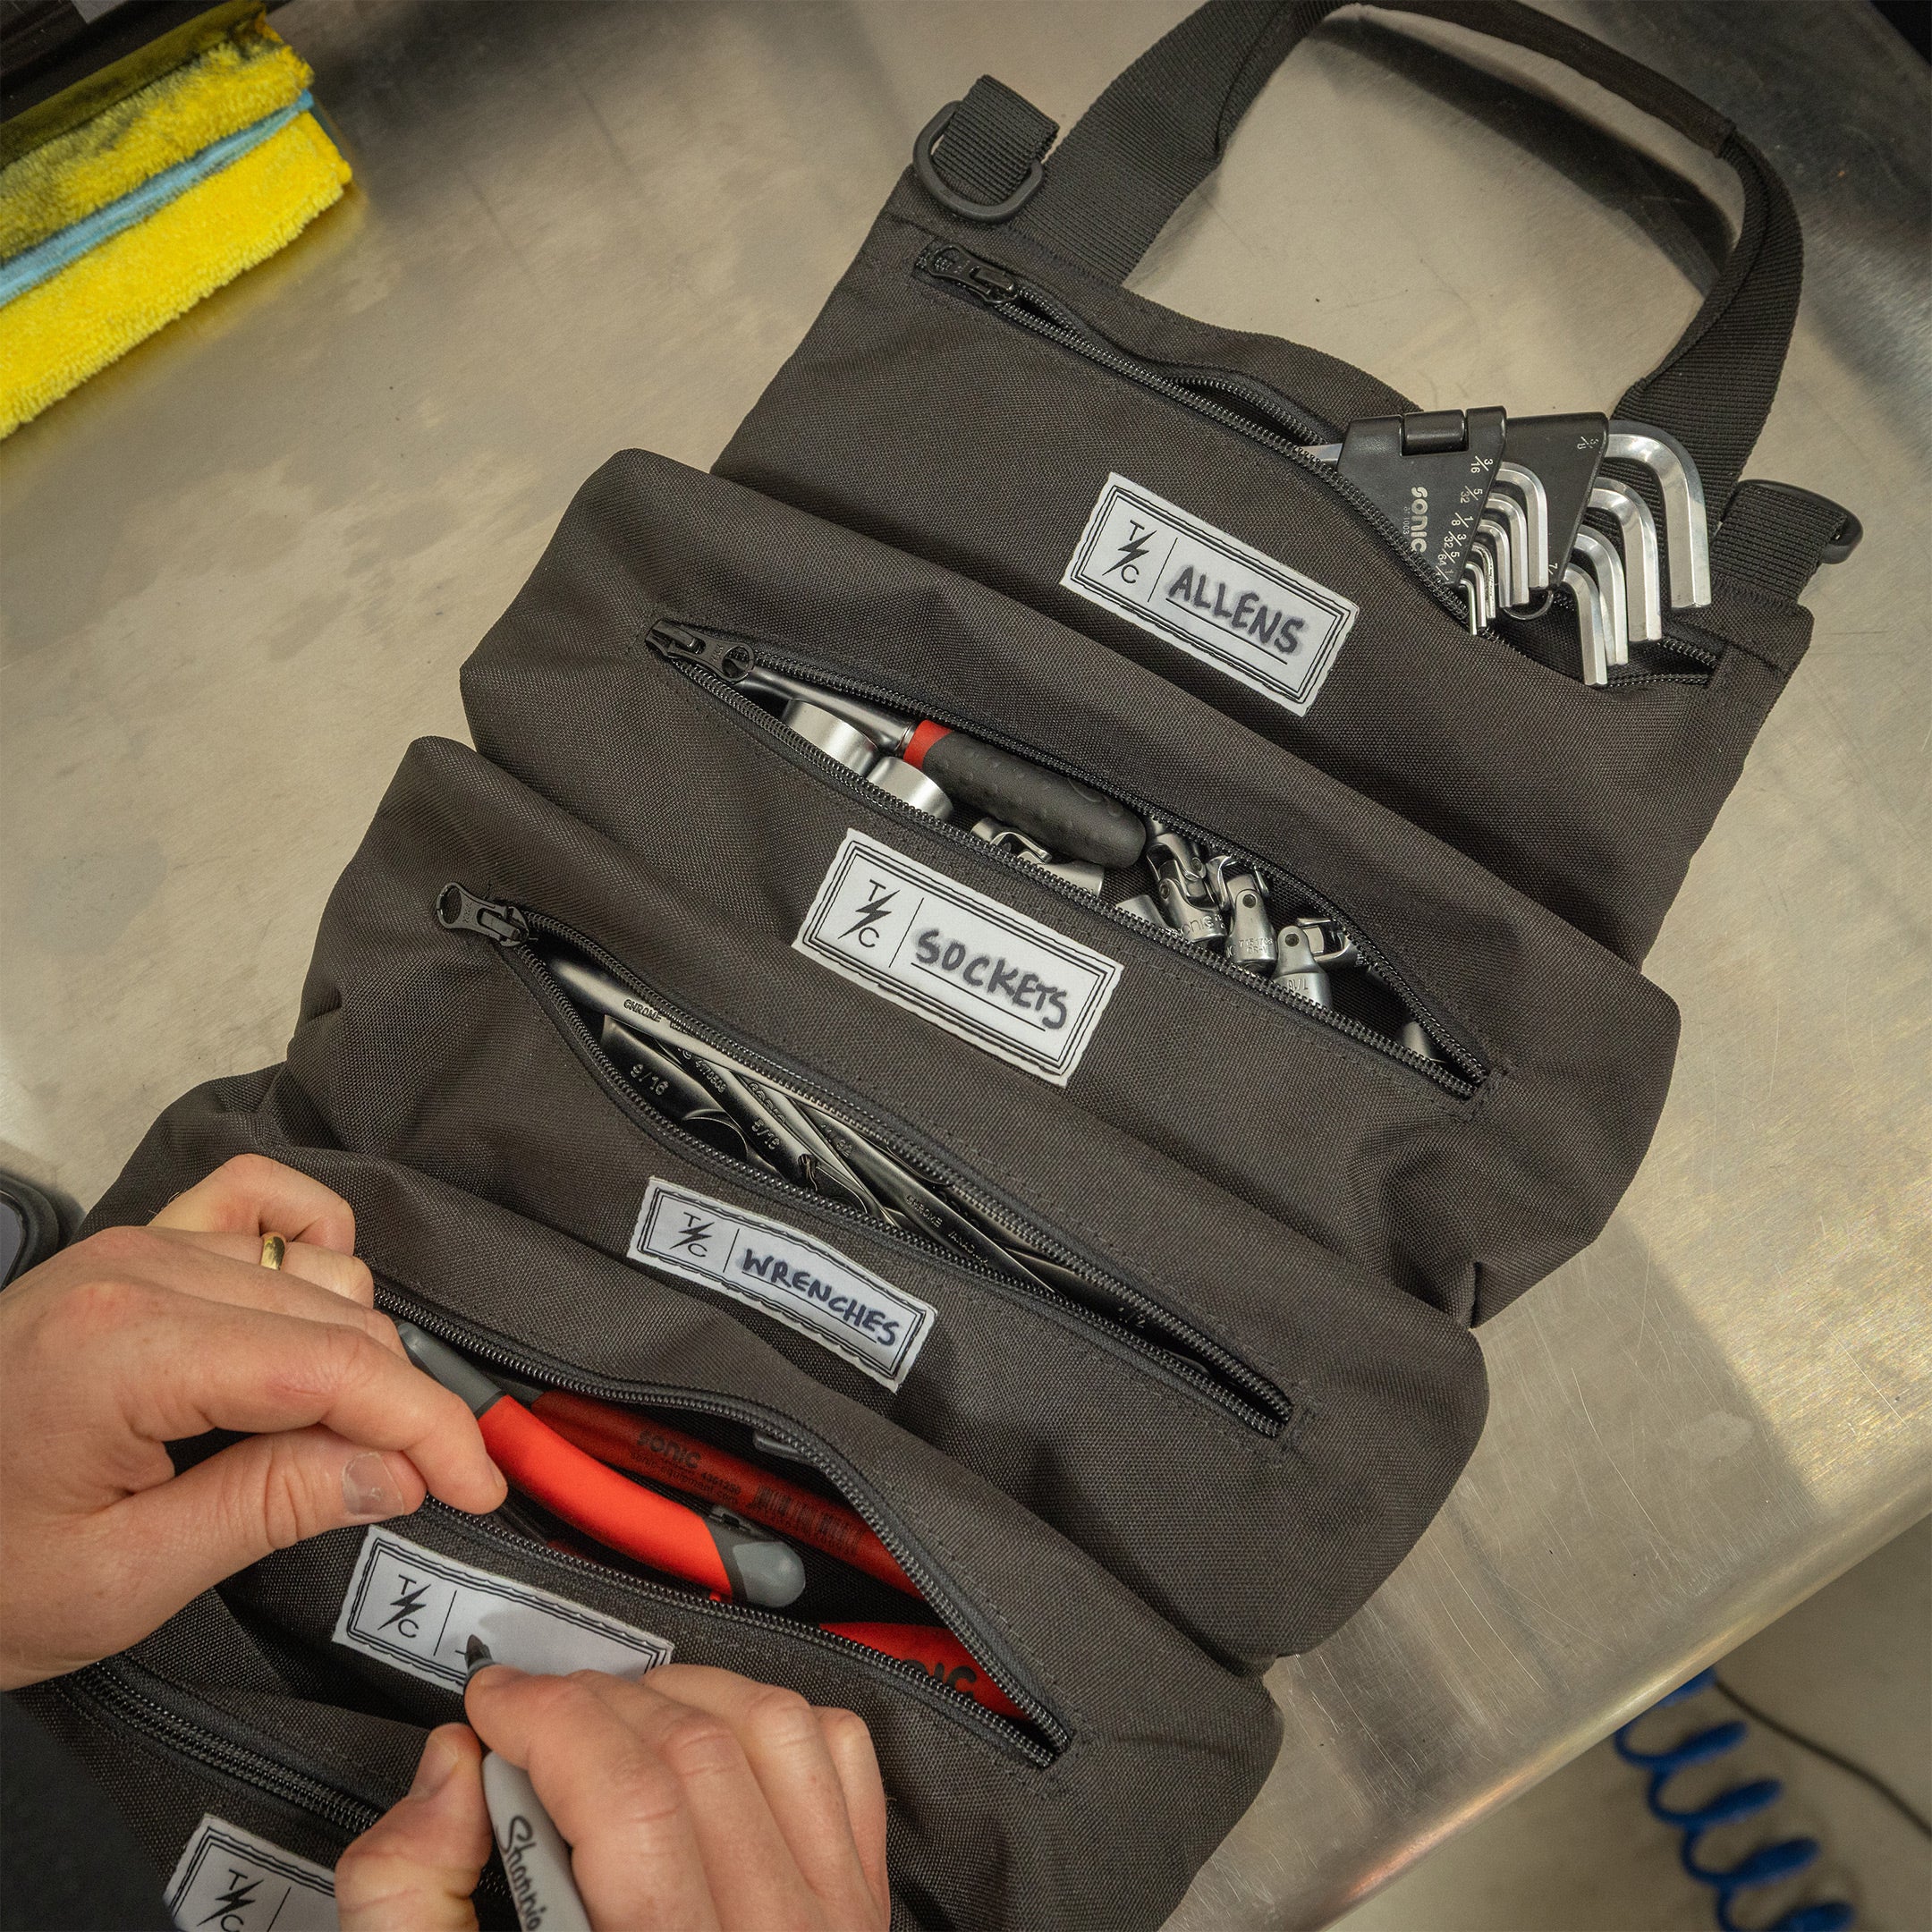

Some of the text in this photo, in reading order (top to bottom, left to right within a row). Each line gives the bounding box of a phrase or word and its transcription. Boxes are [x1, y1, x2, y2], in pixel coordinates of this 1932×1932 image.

[1470, 455, 1494, 474] 3/16
[1460, 485, 1483, 504] 5/32
[1451, 512, 1474, 529] 1/8
[1444, 530, 1467, 548] 3/32
[1167, 564, 1306, 655] ALLENS
[913, 928, 1069, 1030] SOCKETS
[623, 998, 662, 1023] CHROME
[630, 1063, 669, 1096] 9/16
[741, 1248, 901, 1348] WRENCHES
